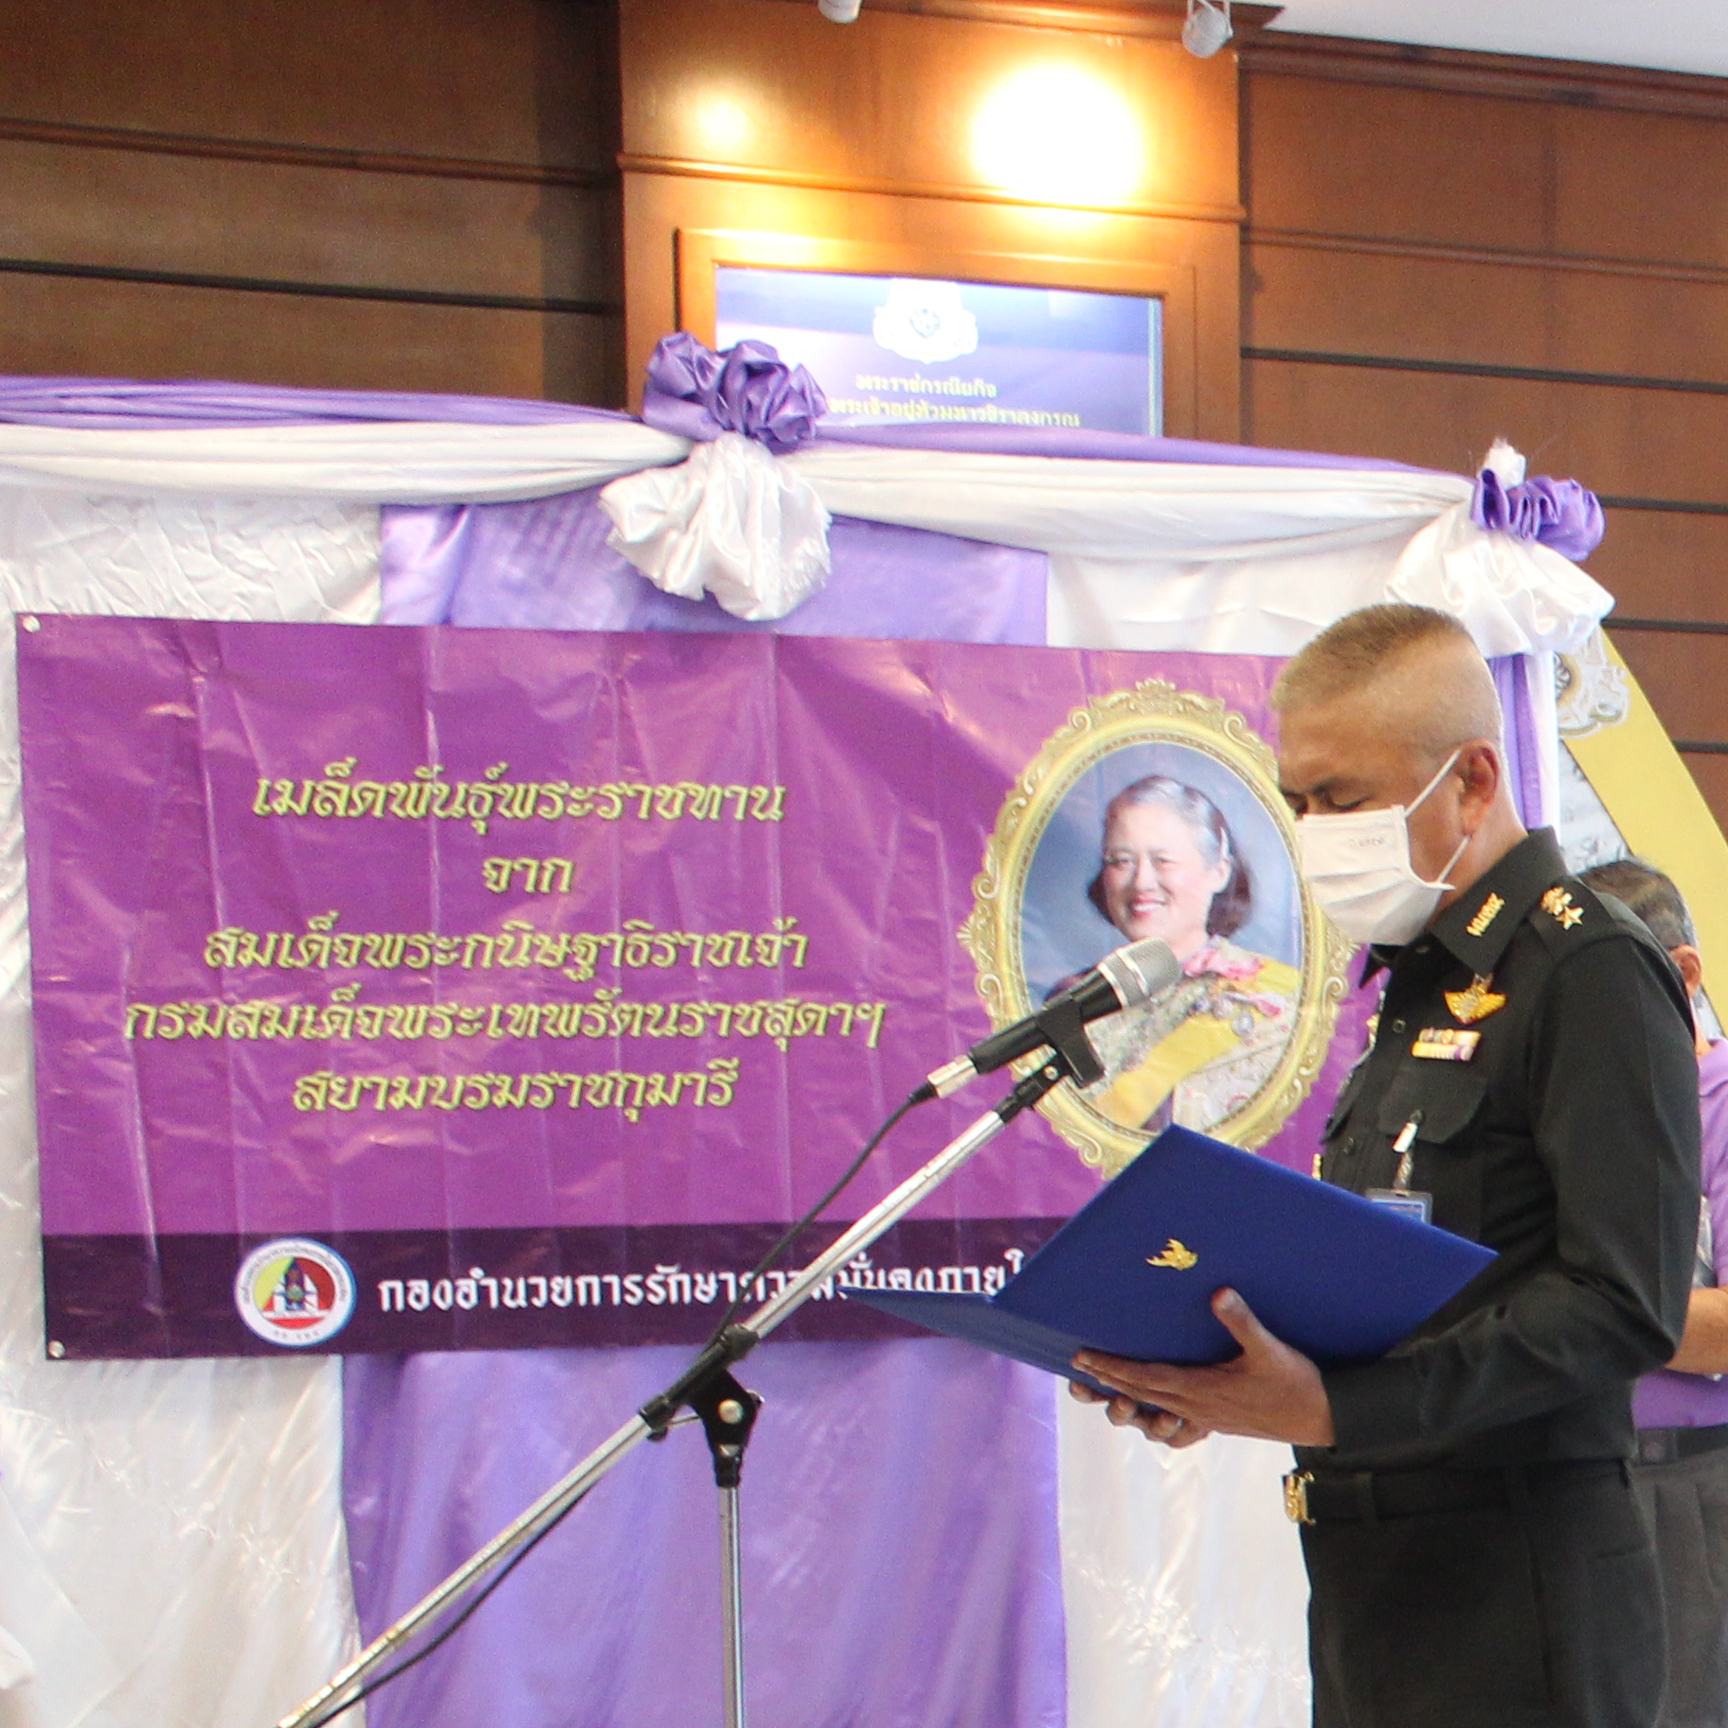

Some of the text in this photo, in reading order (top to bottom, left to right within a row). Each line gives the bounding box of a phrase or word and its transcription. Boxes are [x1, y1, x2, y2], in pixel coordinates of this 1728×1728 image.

[252, 757, 786, 835] เมล็ดพันธุ์พระราชทาน
[481, 855, 574, 894] จาก
[203, 910, 809, 981] สมเด็จพระกนิษฐาธิราชเจ้า
[124, 982, 888, 1053] กรมสมเด็จพระเทพรัตนราชสุดาฯ
[292, 1056, 741, 1122] สยามบรมราชกุมารี
